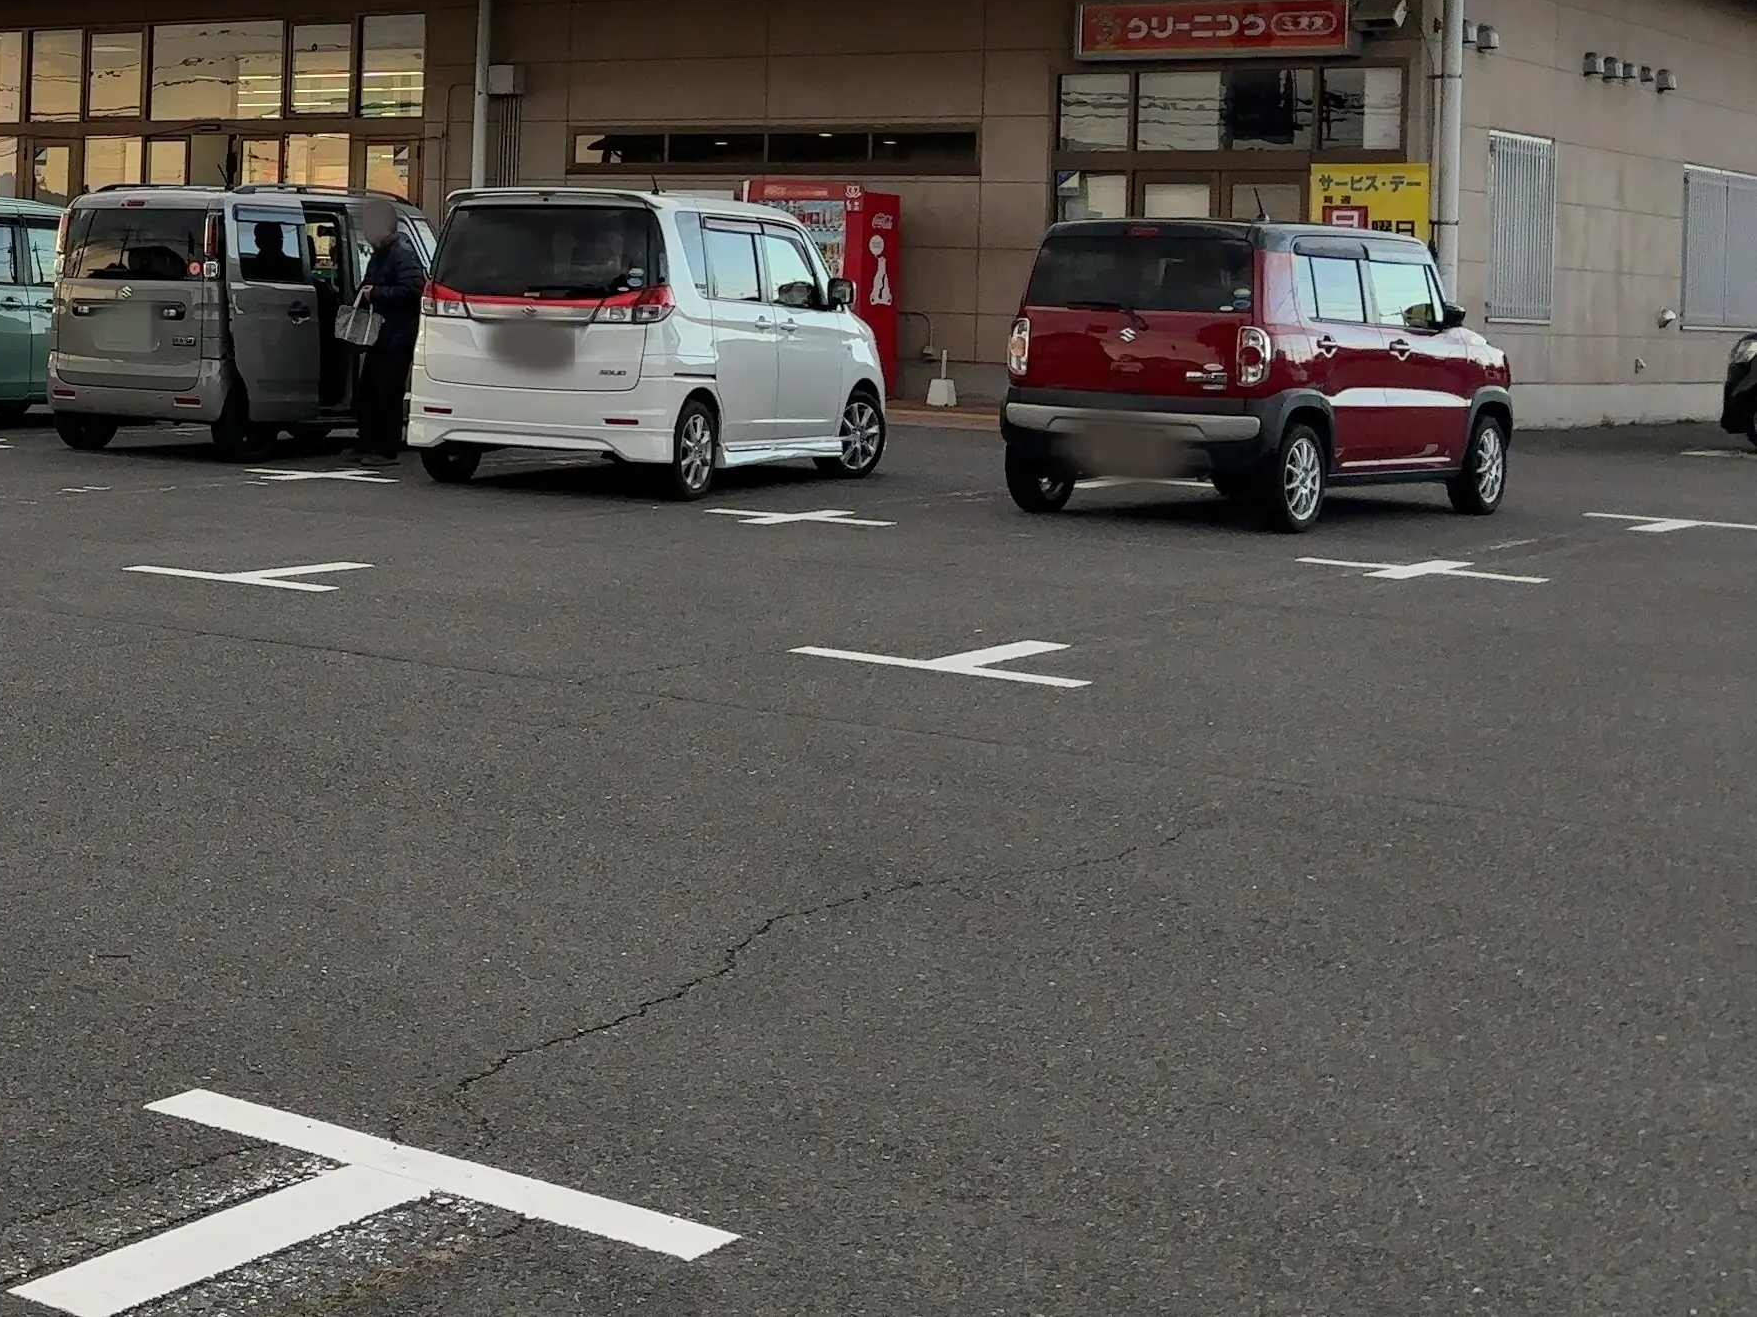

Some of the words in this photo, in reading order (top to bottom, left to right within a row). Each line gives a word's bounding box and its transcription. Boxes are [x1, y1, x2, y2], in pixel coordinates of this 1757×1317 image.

[1319, 175, 1421, 193] サービス・デー
